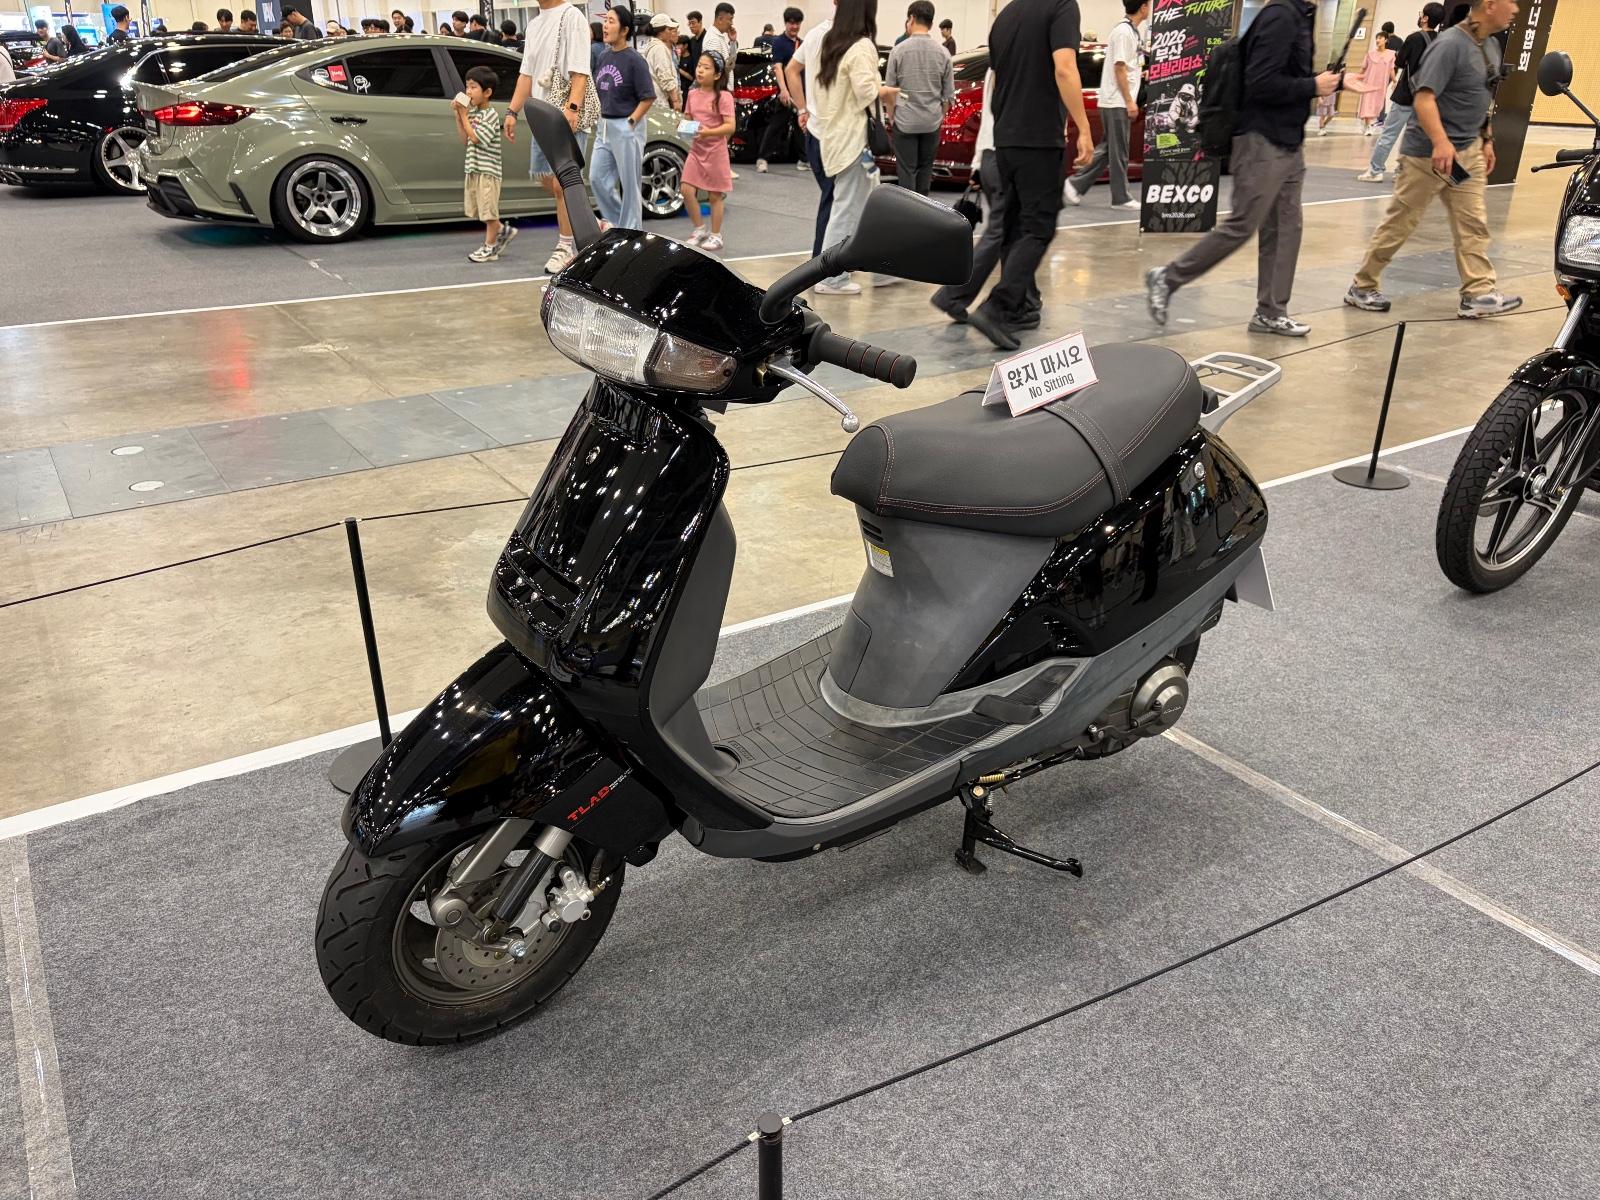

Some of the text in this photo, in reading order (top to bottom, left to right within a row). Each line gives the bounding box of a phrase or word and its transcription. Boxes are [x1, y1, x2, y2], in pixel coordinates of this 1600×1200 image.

[1153, 7, 1184, 24] THE
[1184, 0, 1232, 17] FUTURE
[1151, 29, 1186, 51] 2026
[1518, 0, 1542, 71] 너협회
[1155, 43, 1183, 63] 부산
[1149, 54, 1203, 80] 모빌리티쇼
[1145, 184, 1214, 203] BEXCO
[1007, 345, 1083, 390] 앉지 마시오
[1028, 373, 1075, 400] No Sitting
[567, 786, 609, 820] TLAD
